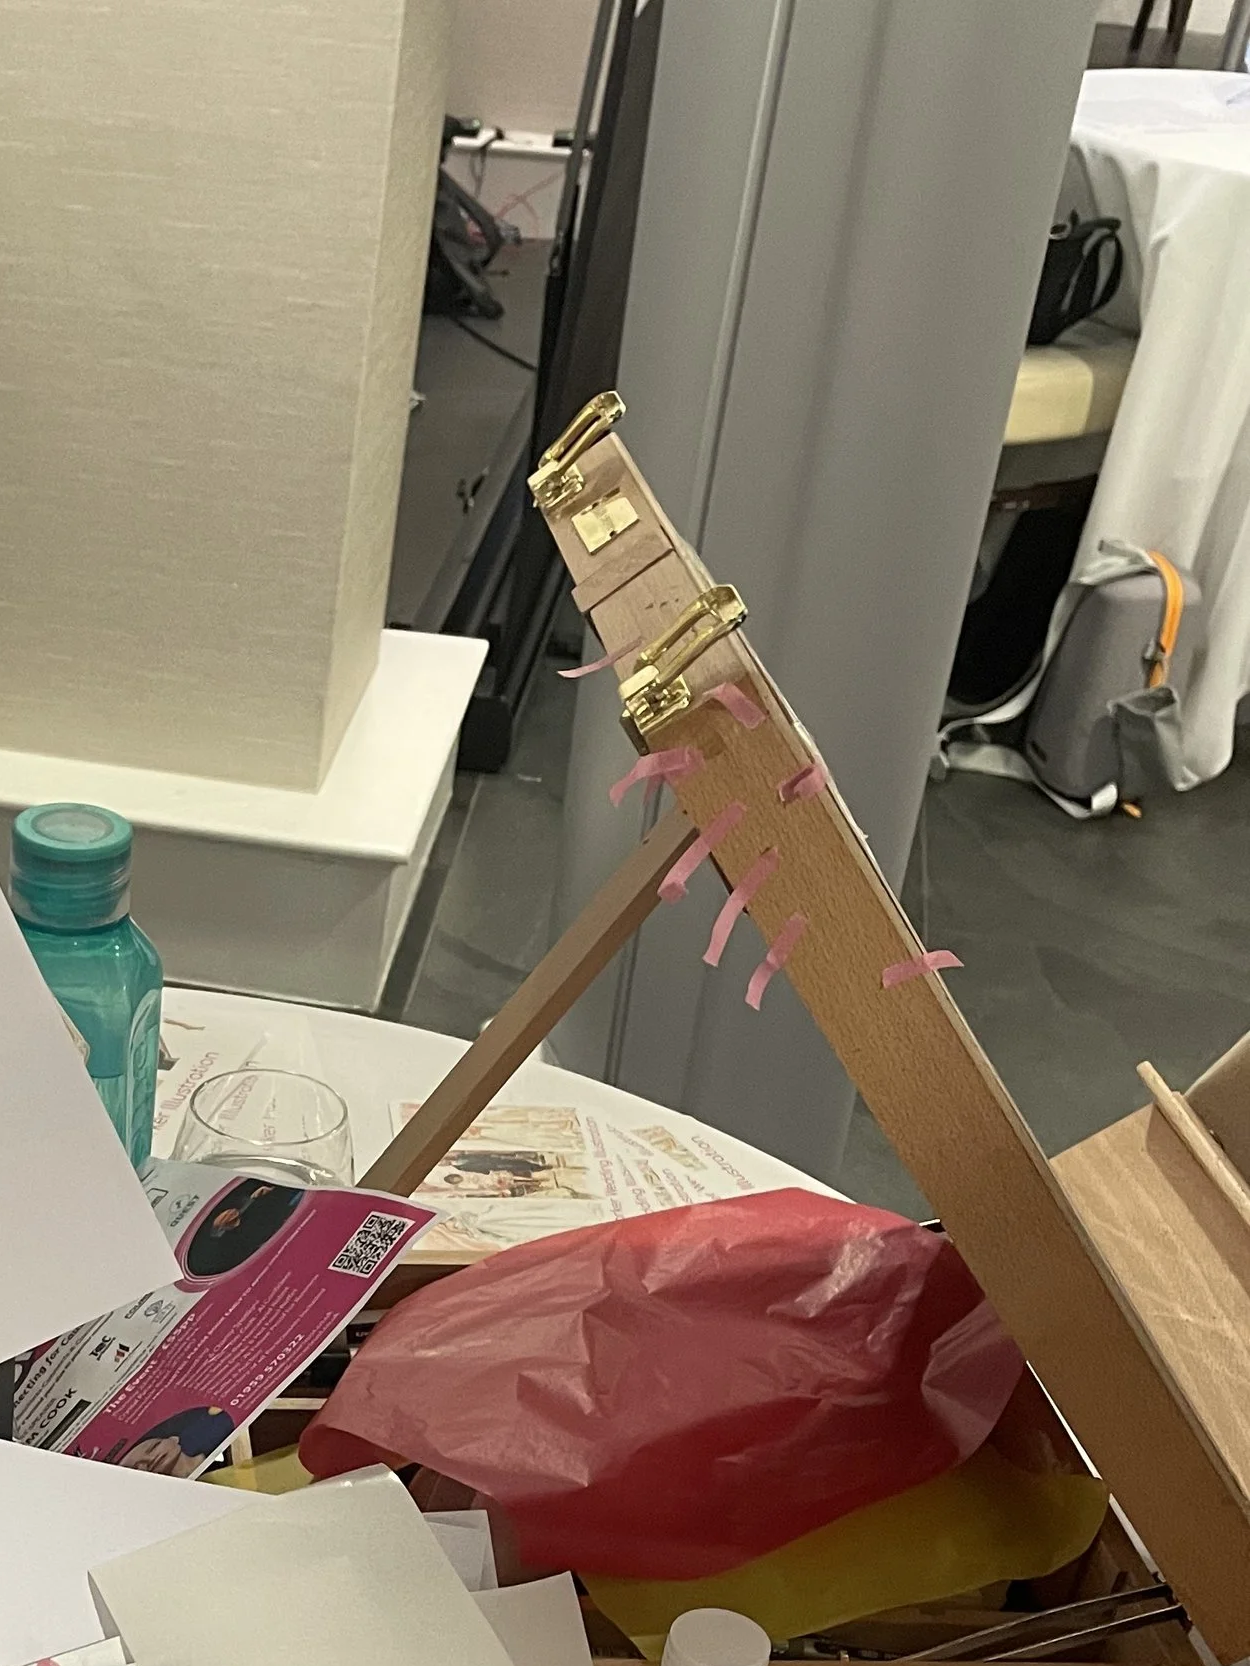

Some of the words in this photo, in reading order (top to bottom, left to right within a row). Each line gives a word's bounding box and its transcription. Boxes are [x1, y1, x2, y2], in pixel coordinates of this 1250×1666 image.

[166, 1052, 219, 1111] Illustration
[168, 1194, 201, 1227] QUEST
[43, 1344, 64, 1366] for
[229, 1372, 265, 1407] 01959
[263, 1332, 304, 1373] 570322
[36, 1386, 78, 1429] COOK
[103, 1391, 127, 1415] The
[123, 1358, 159, 1393] Event
